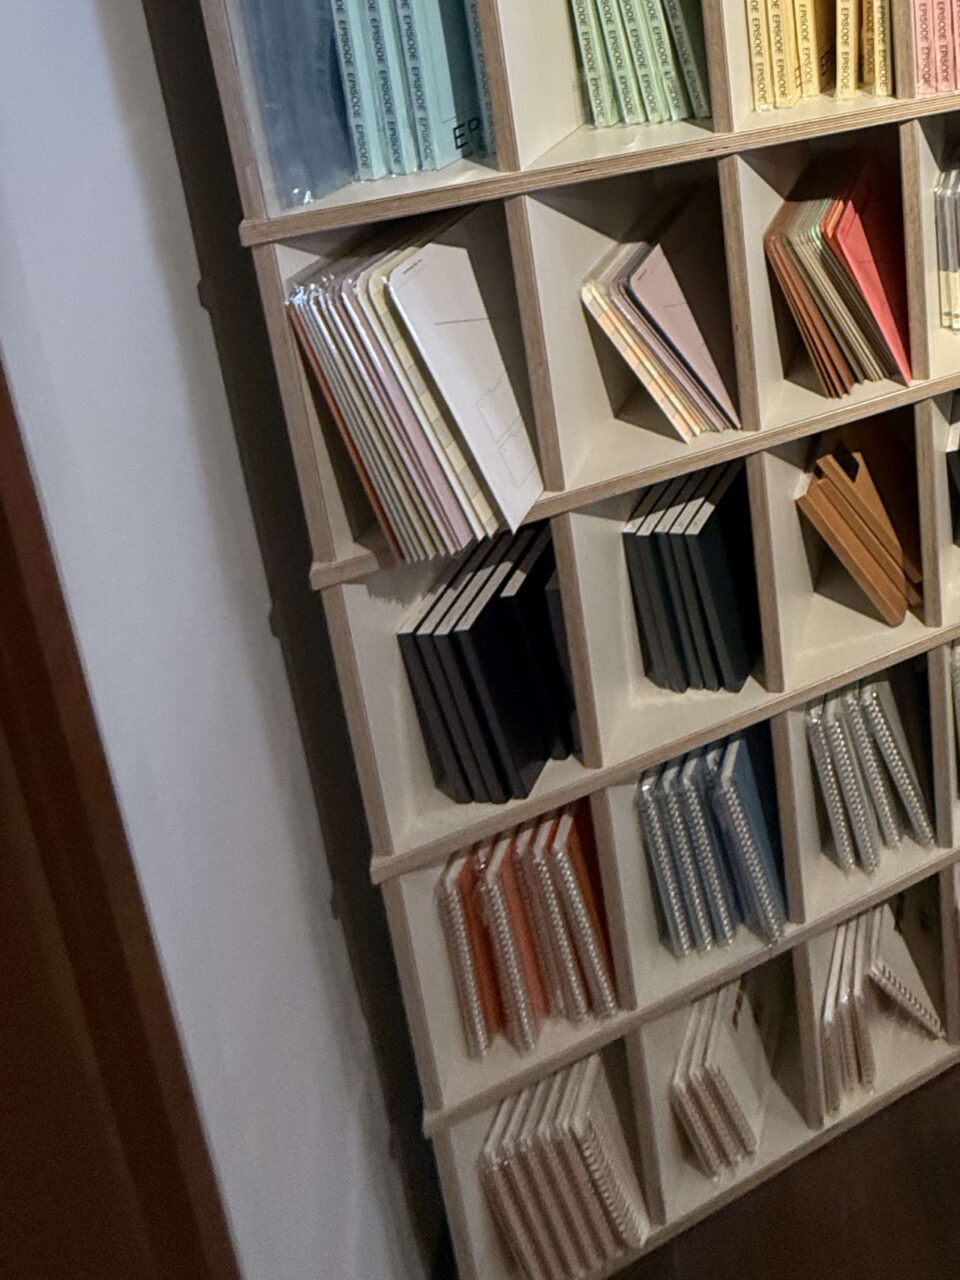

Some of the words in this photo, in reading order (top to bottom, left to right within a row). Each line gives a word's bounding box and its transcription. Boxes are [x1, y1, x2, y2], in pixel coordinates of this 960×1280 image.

[752, 18, 762, 57] EPISODE
[772, 15, 783, 53] EPISODE
[800, 4, 809, 40] EPISODE
[920, 4, 928, 41] EPISODE
[938, 2, 946, 40] EPISODE
[403, 15, 417, 61] EPISODE
[411, 67, 425, 111] EPISODE
[653, 26, 669, 66] EPISODE
[803, 47, 813, 84] EPISODE
[939, 45, 948, 82] EPISODE
[582, 32, 596, 72] EPISODE
[590, 78, 605, 117] EPISODE
[608, 30, 624, 70] EPISODE
[619, 76, 634, 115] EPISODE
[630, 29, 646, 68] EPISODE
[641, 74, 656, 112] EPISODE
[755, 63, 766, 104] EPISODE
[776, 59, 787, 97] EPISODE
[879, 50, 888, 87] EPISODE
[339, 21, 352, 66] EPISODE
[347, 72, 362, 118] EPISODE
[355, 124, 369, 168] EPISODE
[370, 18, 385, 64] EPISODE
[379, 71, 393, 114] EPISODE
[387, 121, 400, 163] EPISODE
